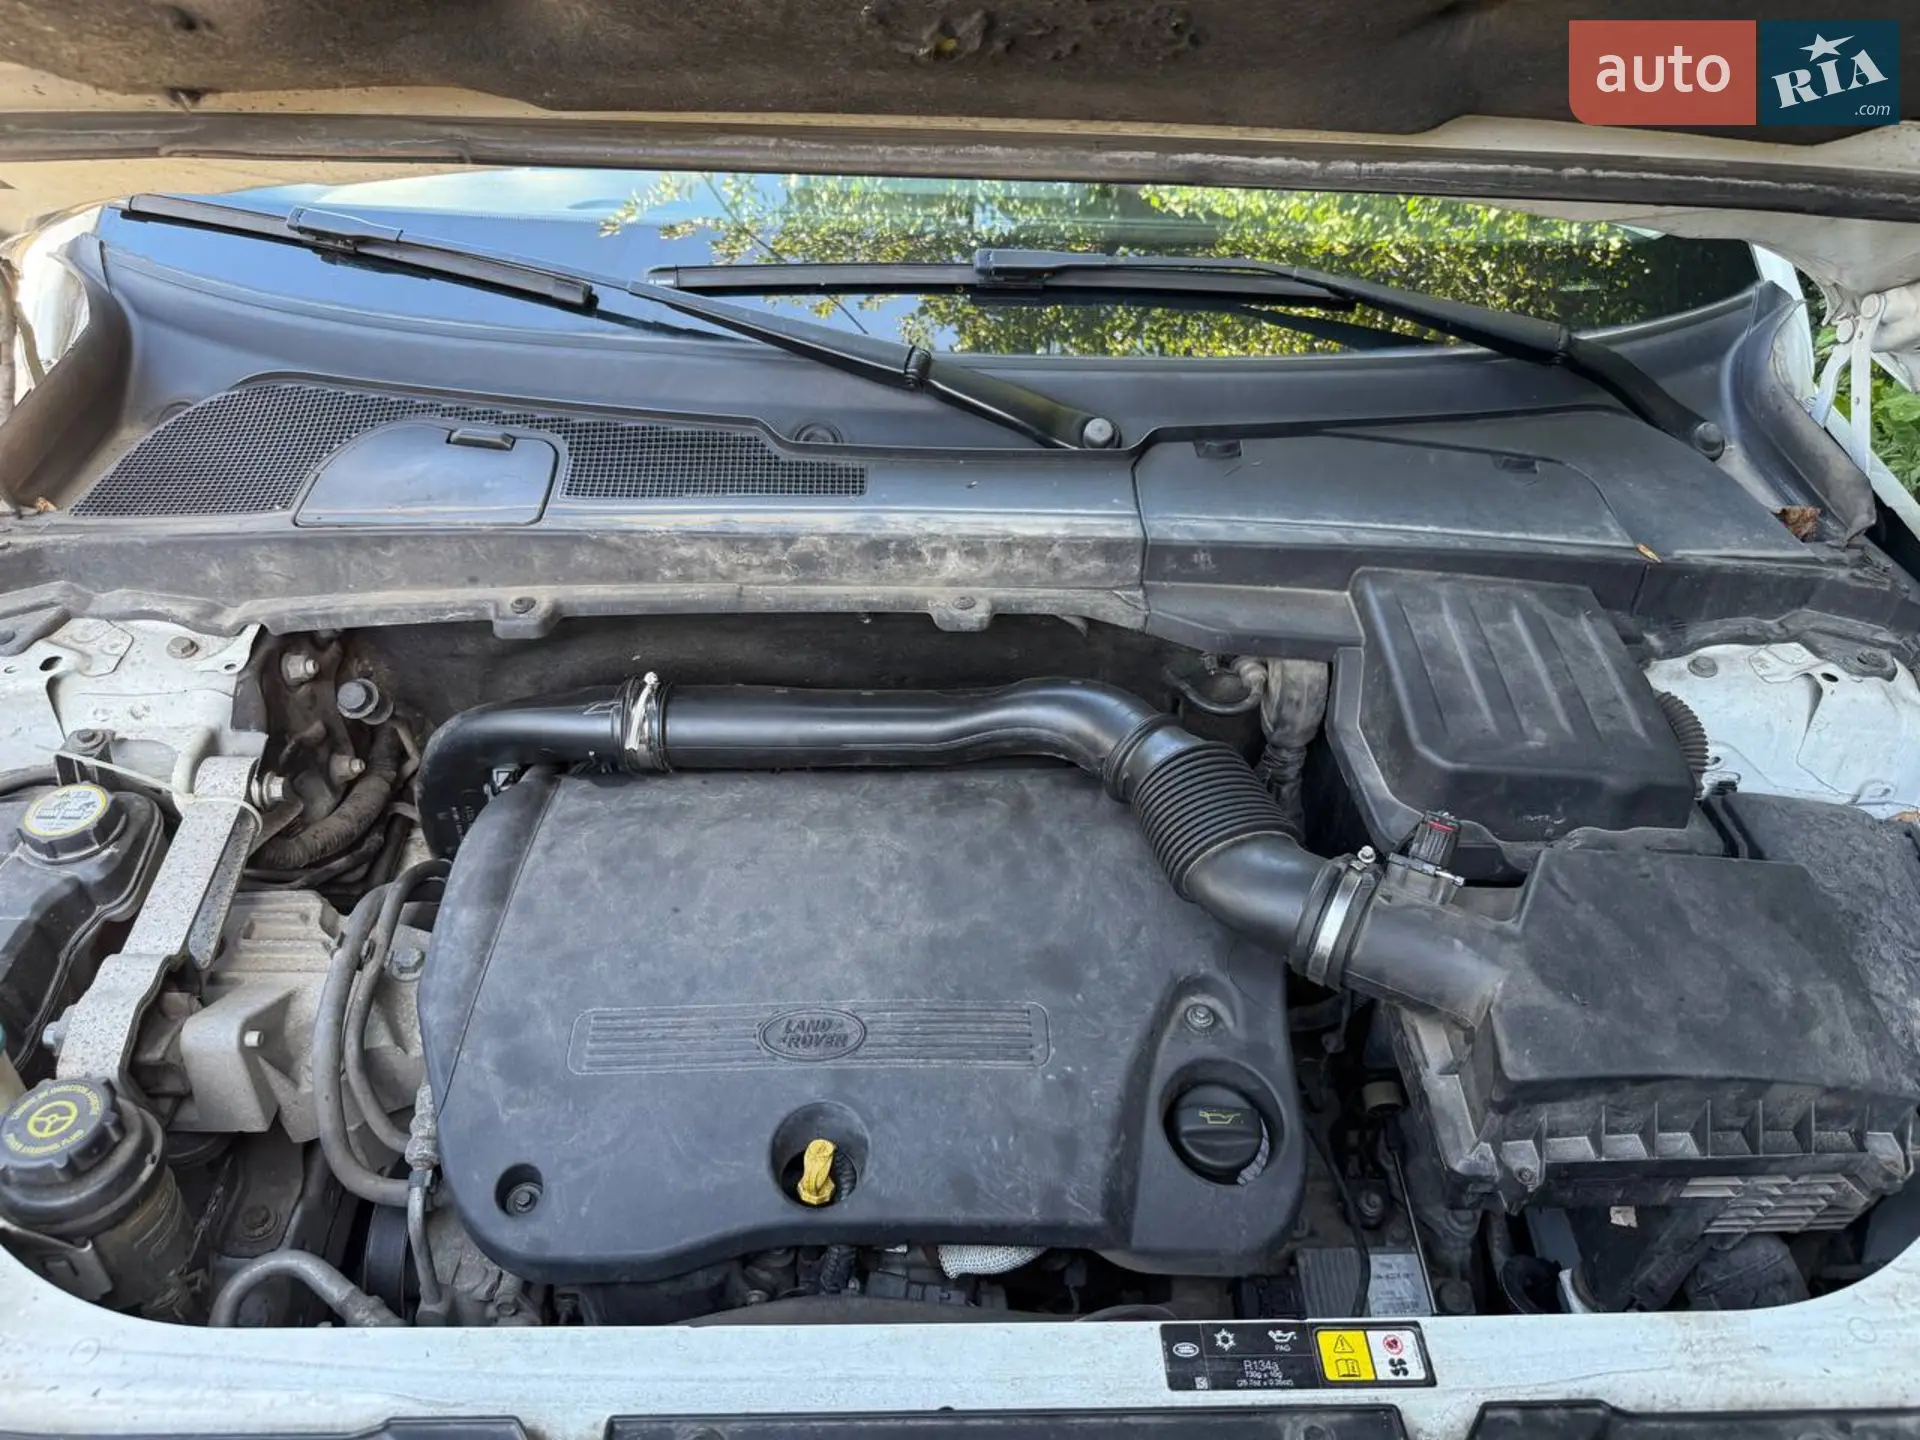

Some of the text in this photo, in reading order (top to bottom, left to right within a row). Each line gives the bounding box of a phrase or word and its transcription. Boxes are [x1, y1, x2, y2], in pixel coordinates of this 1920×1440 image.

[784, 1018, 833, 1034] LAND
[786, 1033, 849, 1049] ROVER
[1243, 1359, 1280, 1372] R134a
